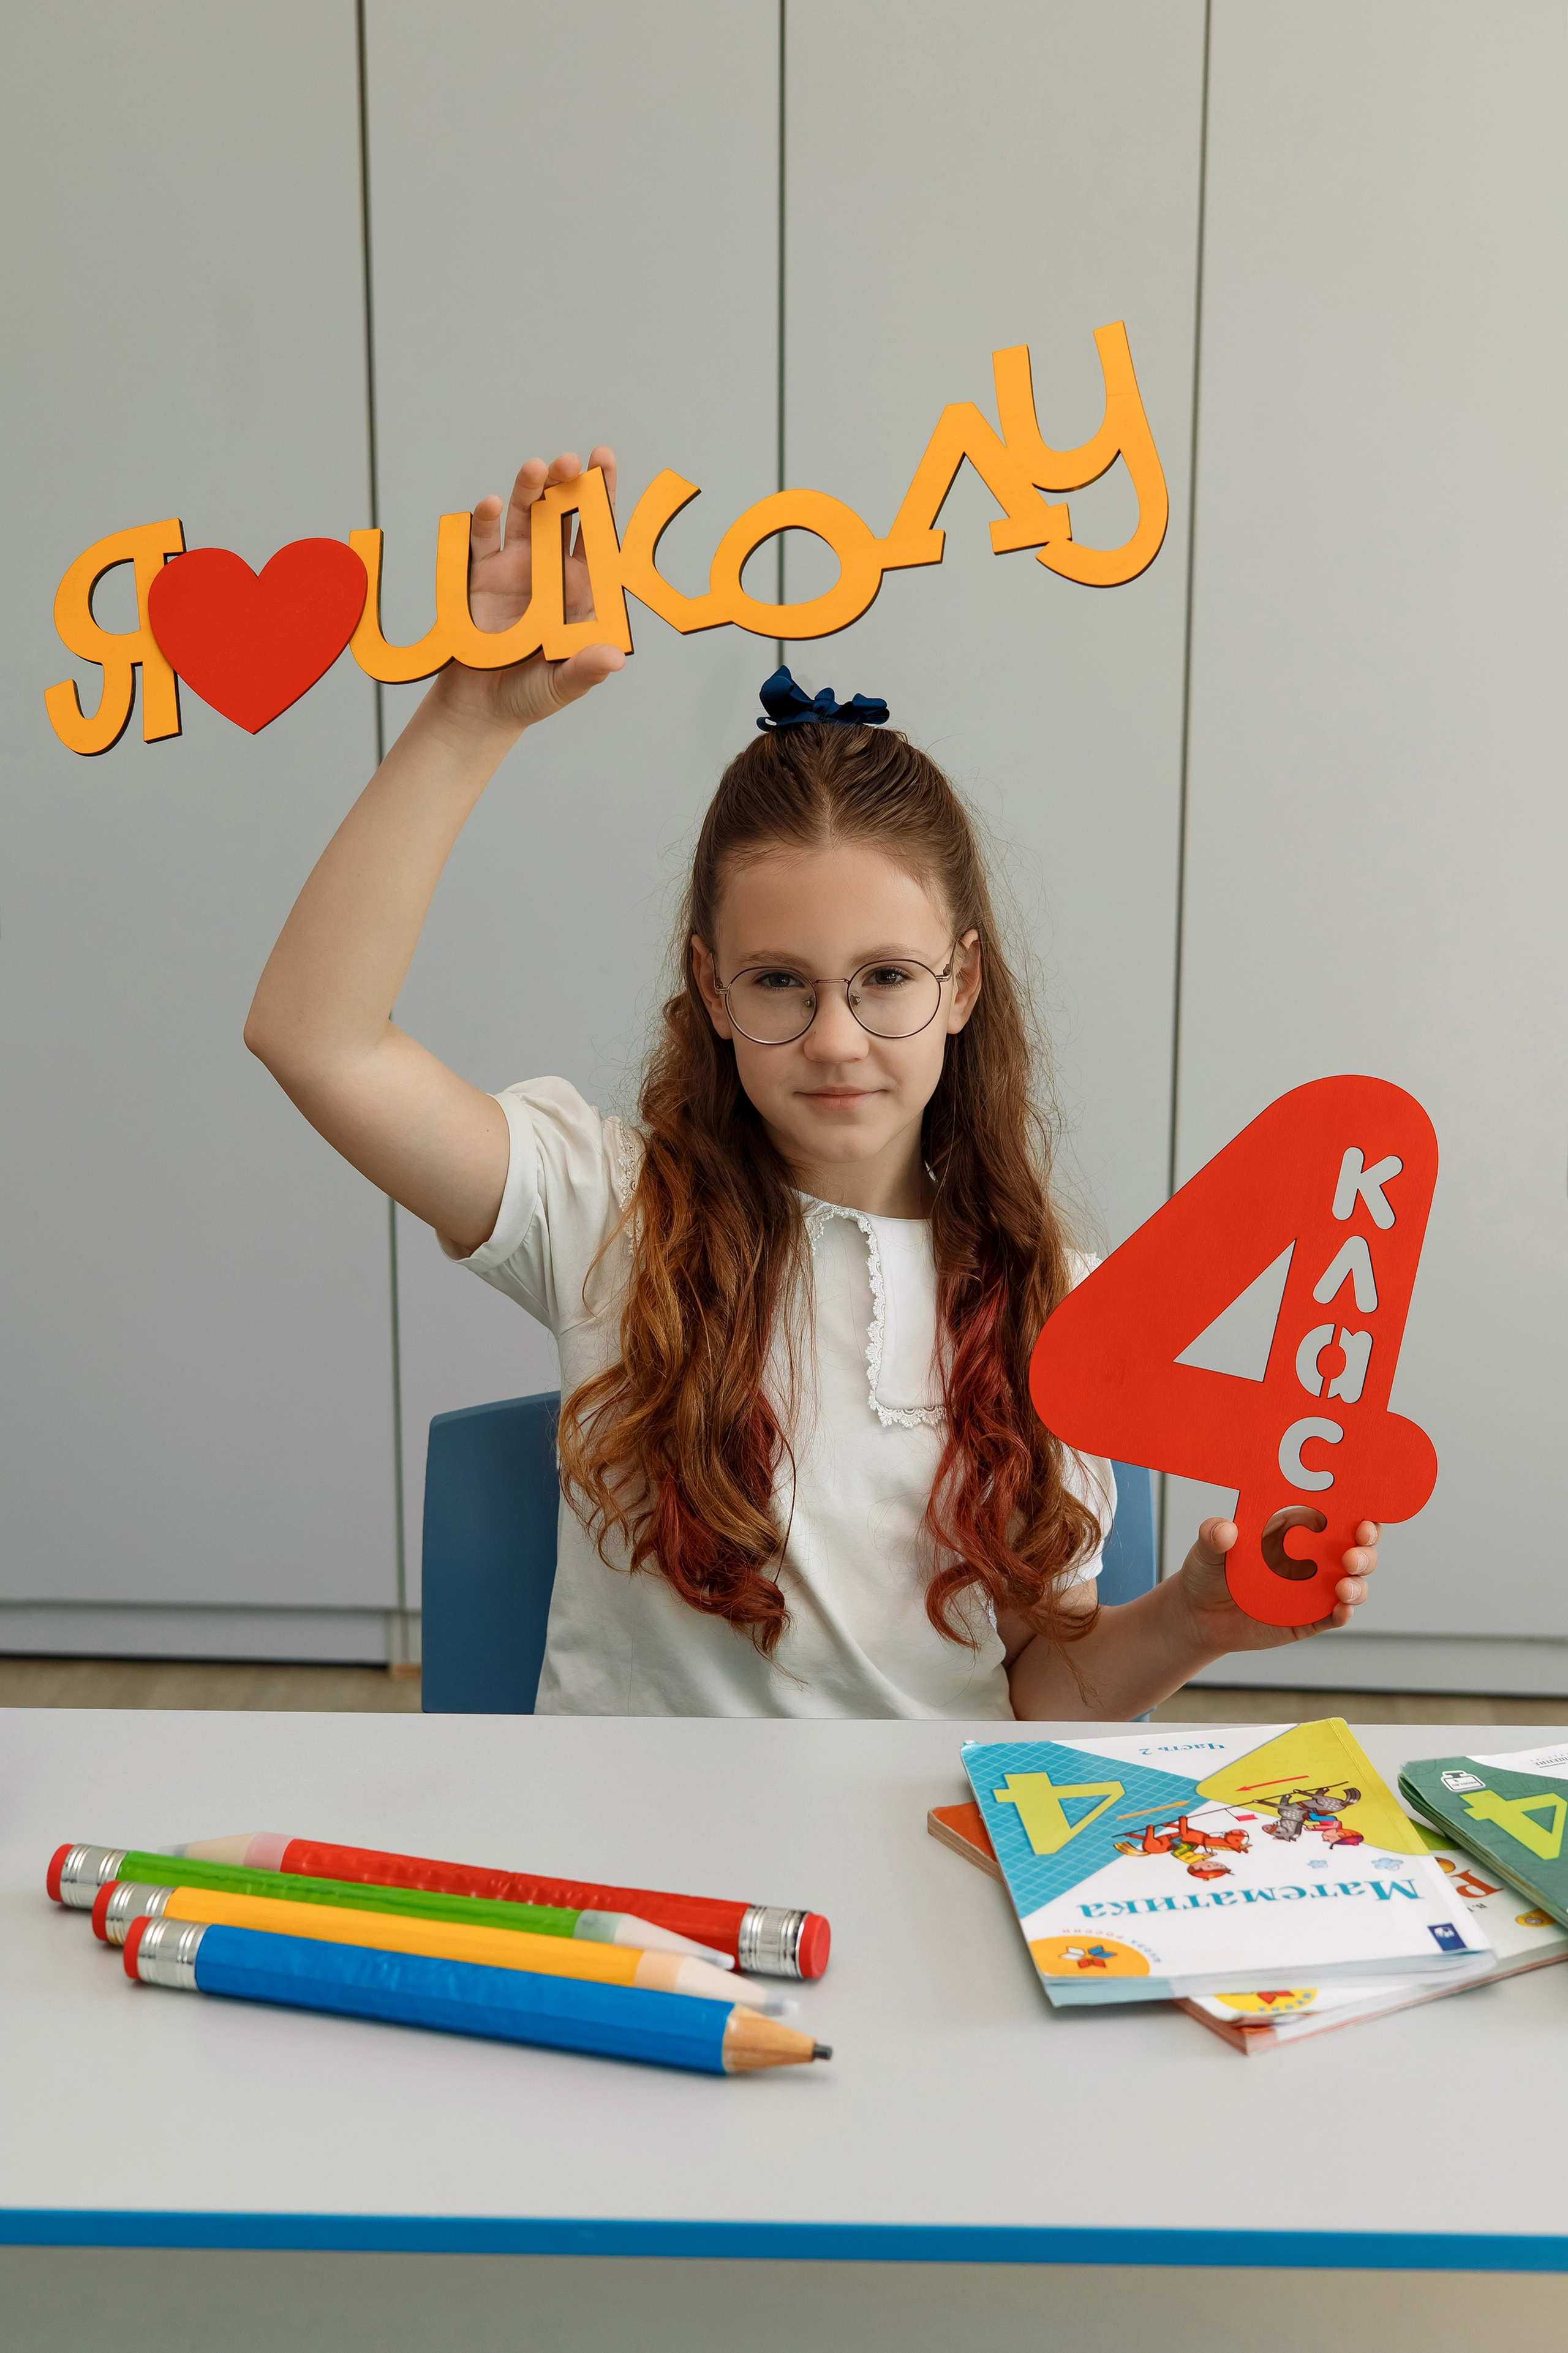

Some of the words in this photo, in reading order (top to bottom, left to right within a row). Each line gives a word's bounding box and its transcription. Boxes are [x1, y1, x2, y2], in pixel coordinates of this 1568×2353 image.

[45, 518, 187, 757] Я
[1029, 1075, 1438, 1627] 4
[1157, 1742, 1226, 1751] Часть
[1534, 1756, 1568, 1766] ЩЕНИЕ
[993, 1772, 1126, 1856] 4
[1459, 1789, 1568, 1860] 4
[1076, 1878, 1425, 1918] Математика
